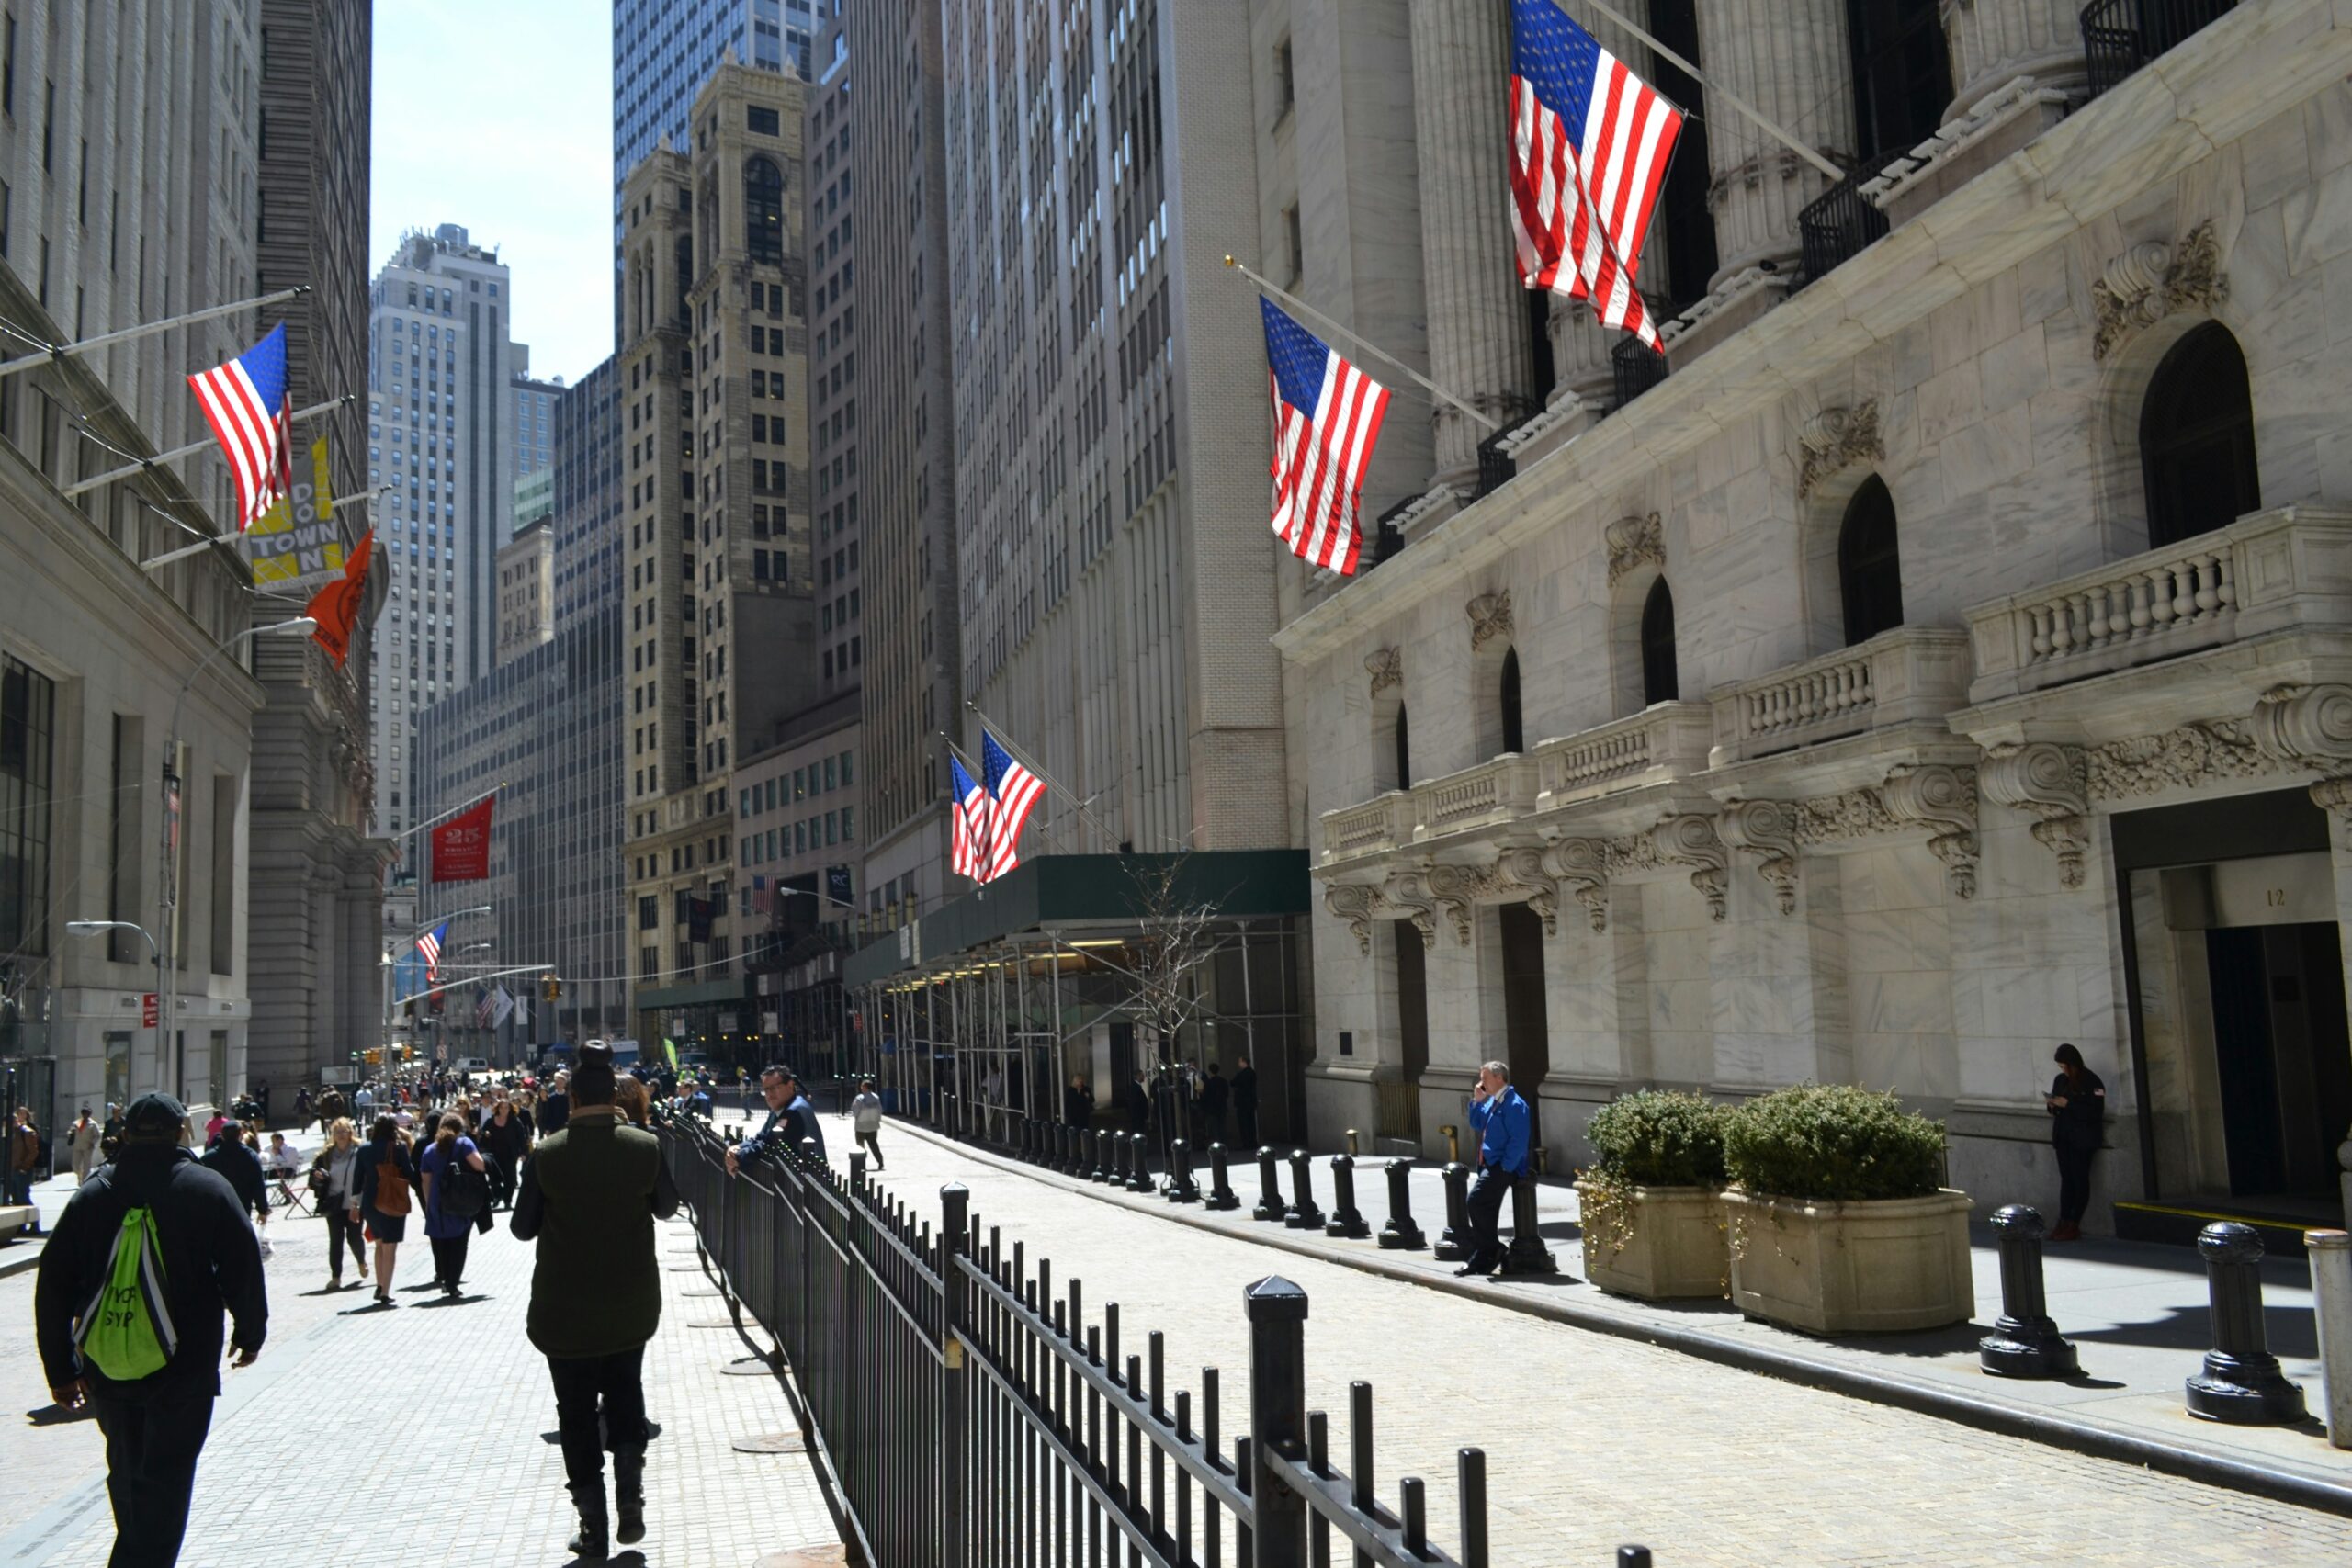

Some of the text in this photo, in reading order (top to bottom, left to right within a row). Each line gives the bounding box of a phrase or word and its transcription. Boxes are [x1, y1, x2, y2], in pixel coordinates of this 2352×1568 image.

[251, 521, 339, 558] TOWN
[446, 828, 479, 844] 25
[2267, 889, 2285, 907] 12
